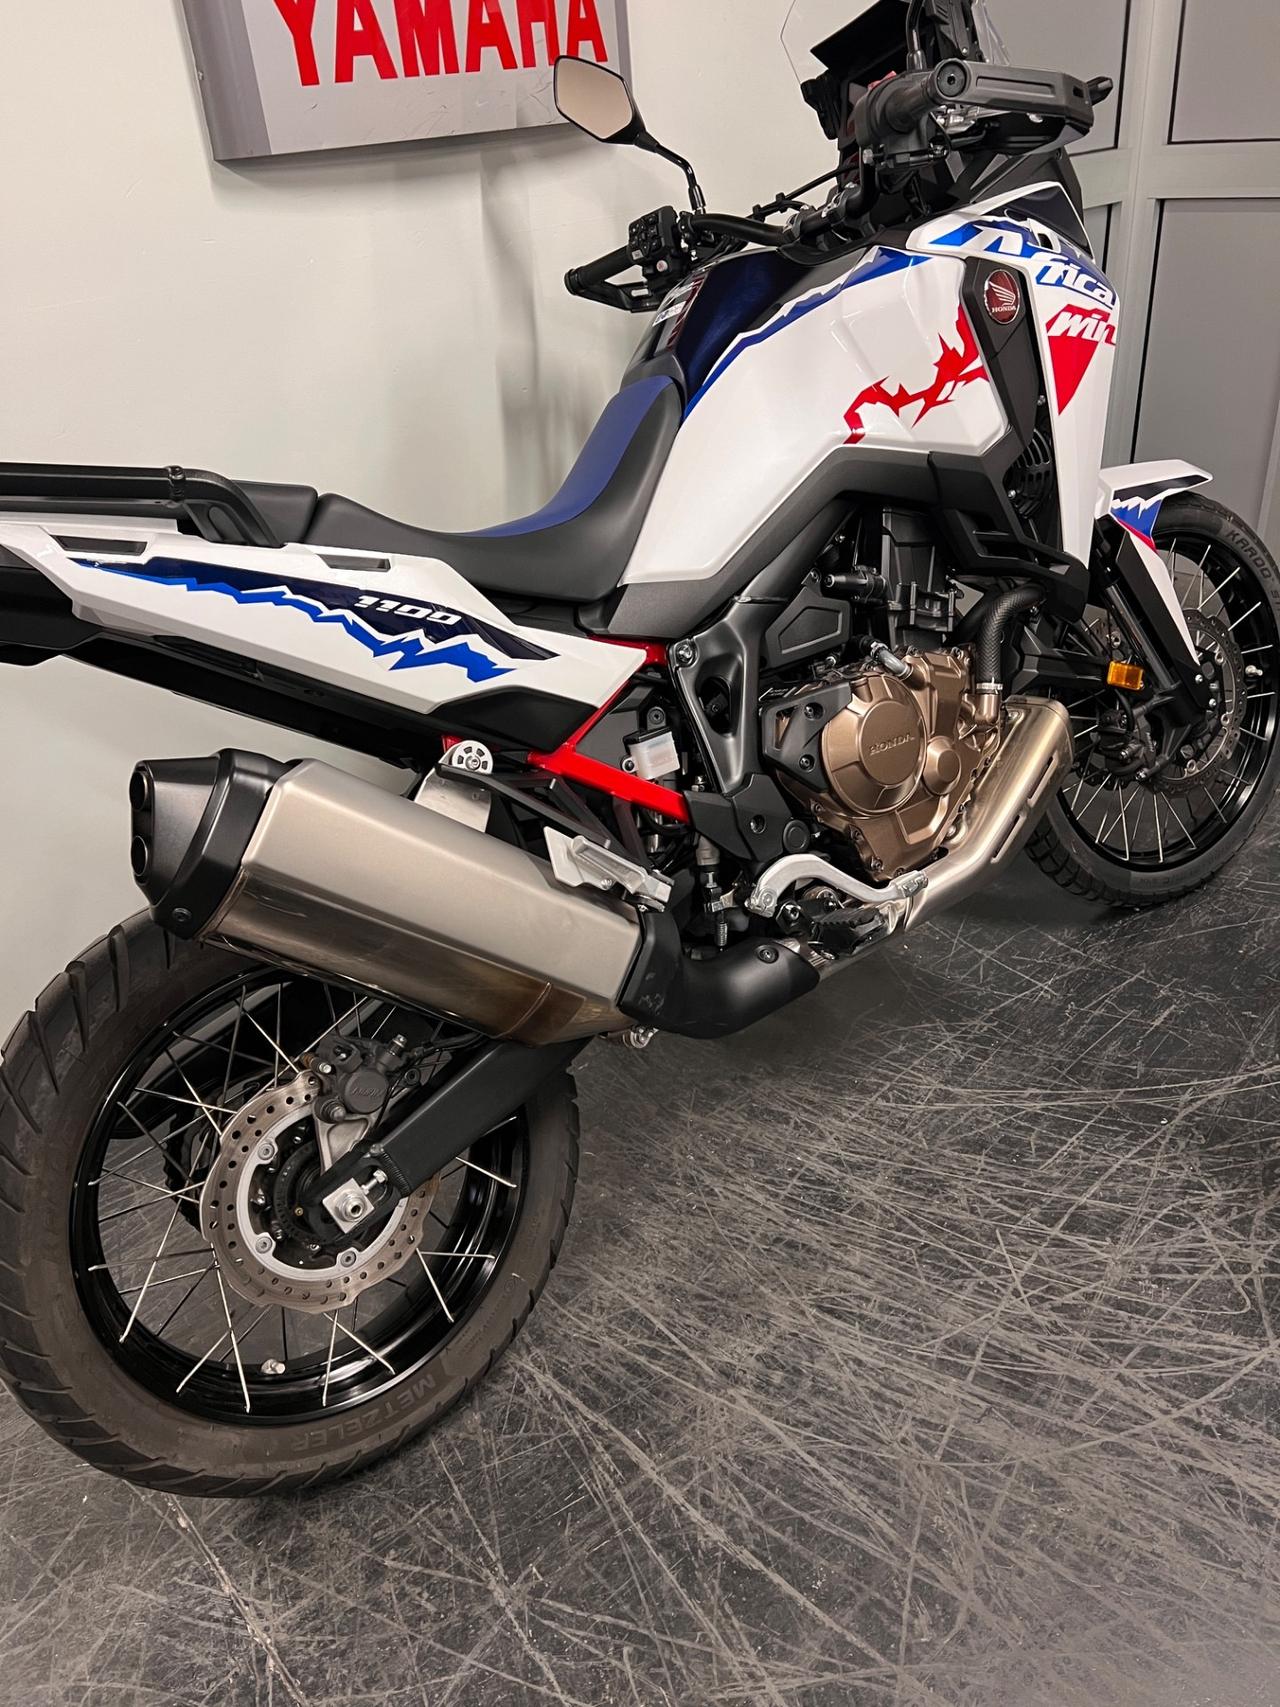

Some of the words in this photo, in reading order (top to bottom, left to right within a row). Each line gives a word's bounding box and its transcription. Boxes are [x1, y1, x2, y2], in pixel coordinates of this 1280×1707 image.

[273, 0, 608, 86] YAMAHA
[991, 305, 1016, 313] HONDA
[353, 595, 462, 626] 1100
[870, 733, 915, 756] HONDA
